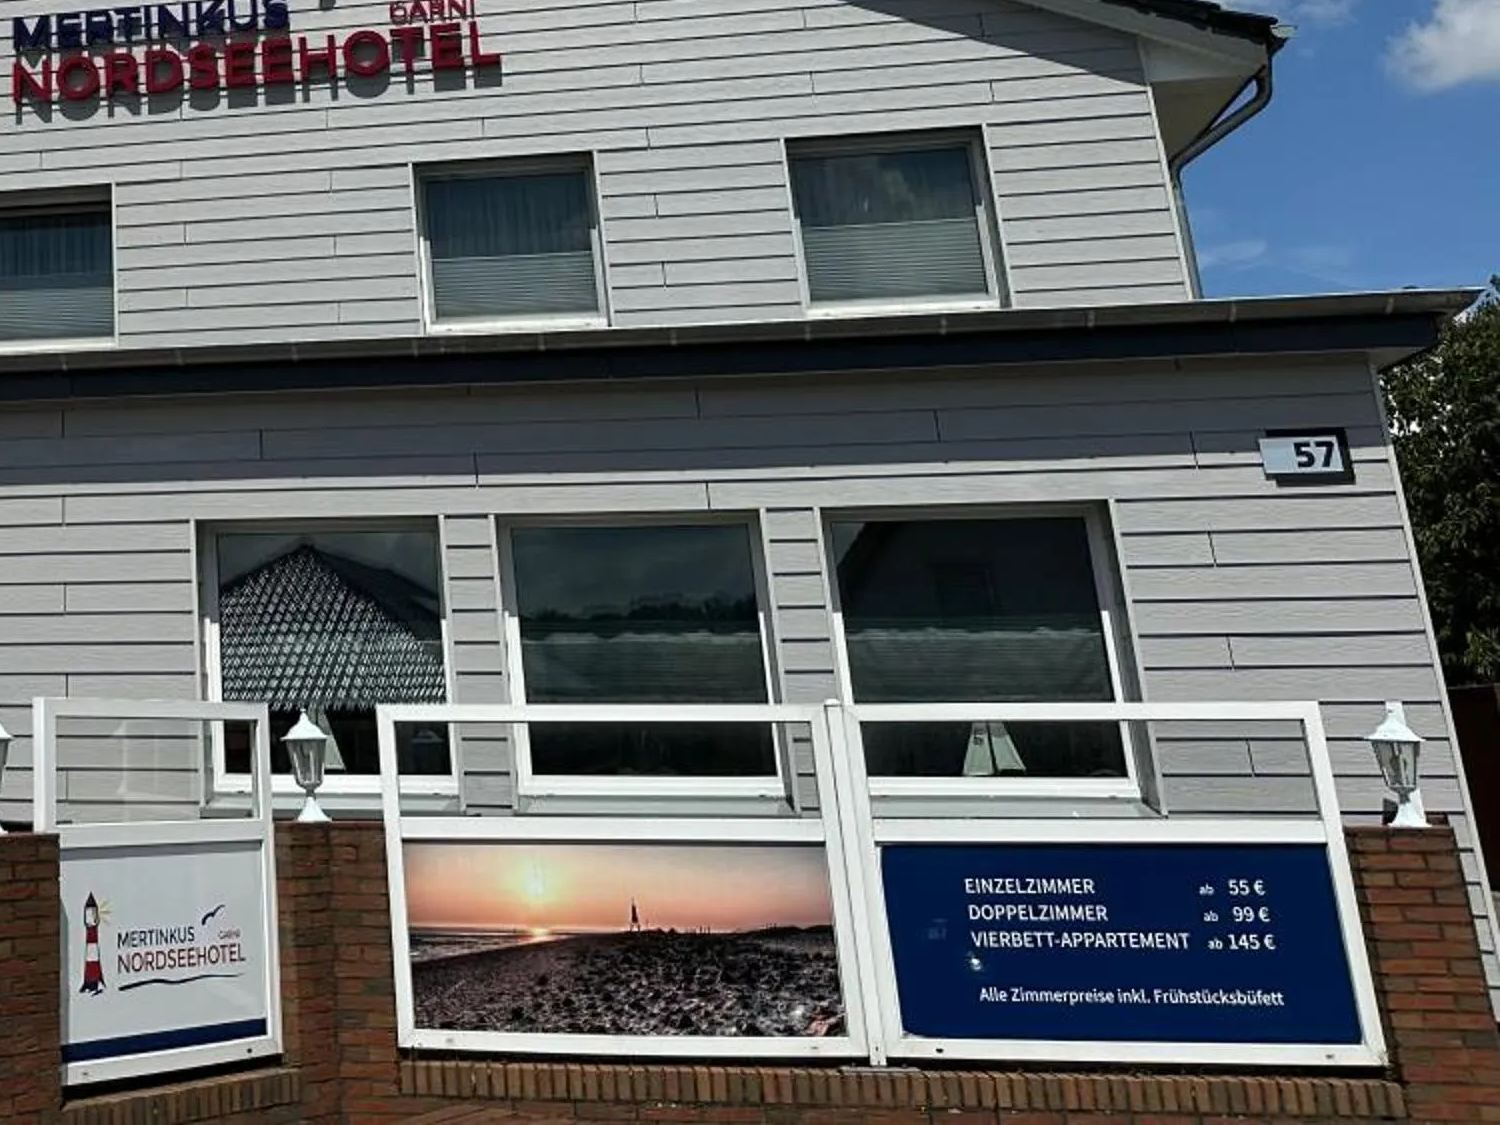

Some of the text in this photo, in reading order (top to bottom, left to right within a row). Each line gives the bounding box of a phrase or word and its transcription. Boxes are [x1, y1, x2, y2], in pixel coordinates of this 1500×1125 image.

[12, 21, 502, 105] NORDSEEHOTEL
[1293, 440, 1335, 468] 57
[964, 878, 1267, 896] EINZELZIMMER ab 55 €
[967, 904, 1271, 923] DOPPELZIMMER ab 99 €
[117, 926, 195, 949] MERTINKUS
[970, 930, 1277, 950] VIERBETT-APPARTEMENT ab 145 €
[117, 943, 246, 974] NORDSEEHOTEL
[979, 987, 1285, 1007] Alle Zimmerpreise inkl. Frühstücksbüfett
